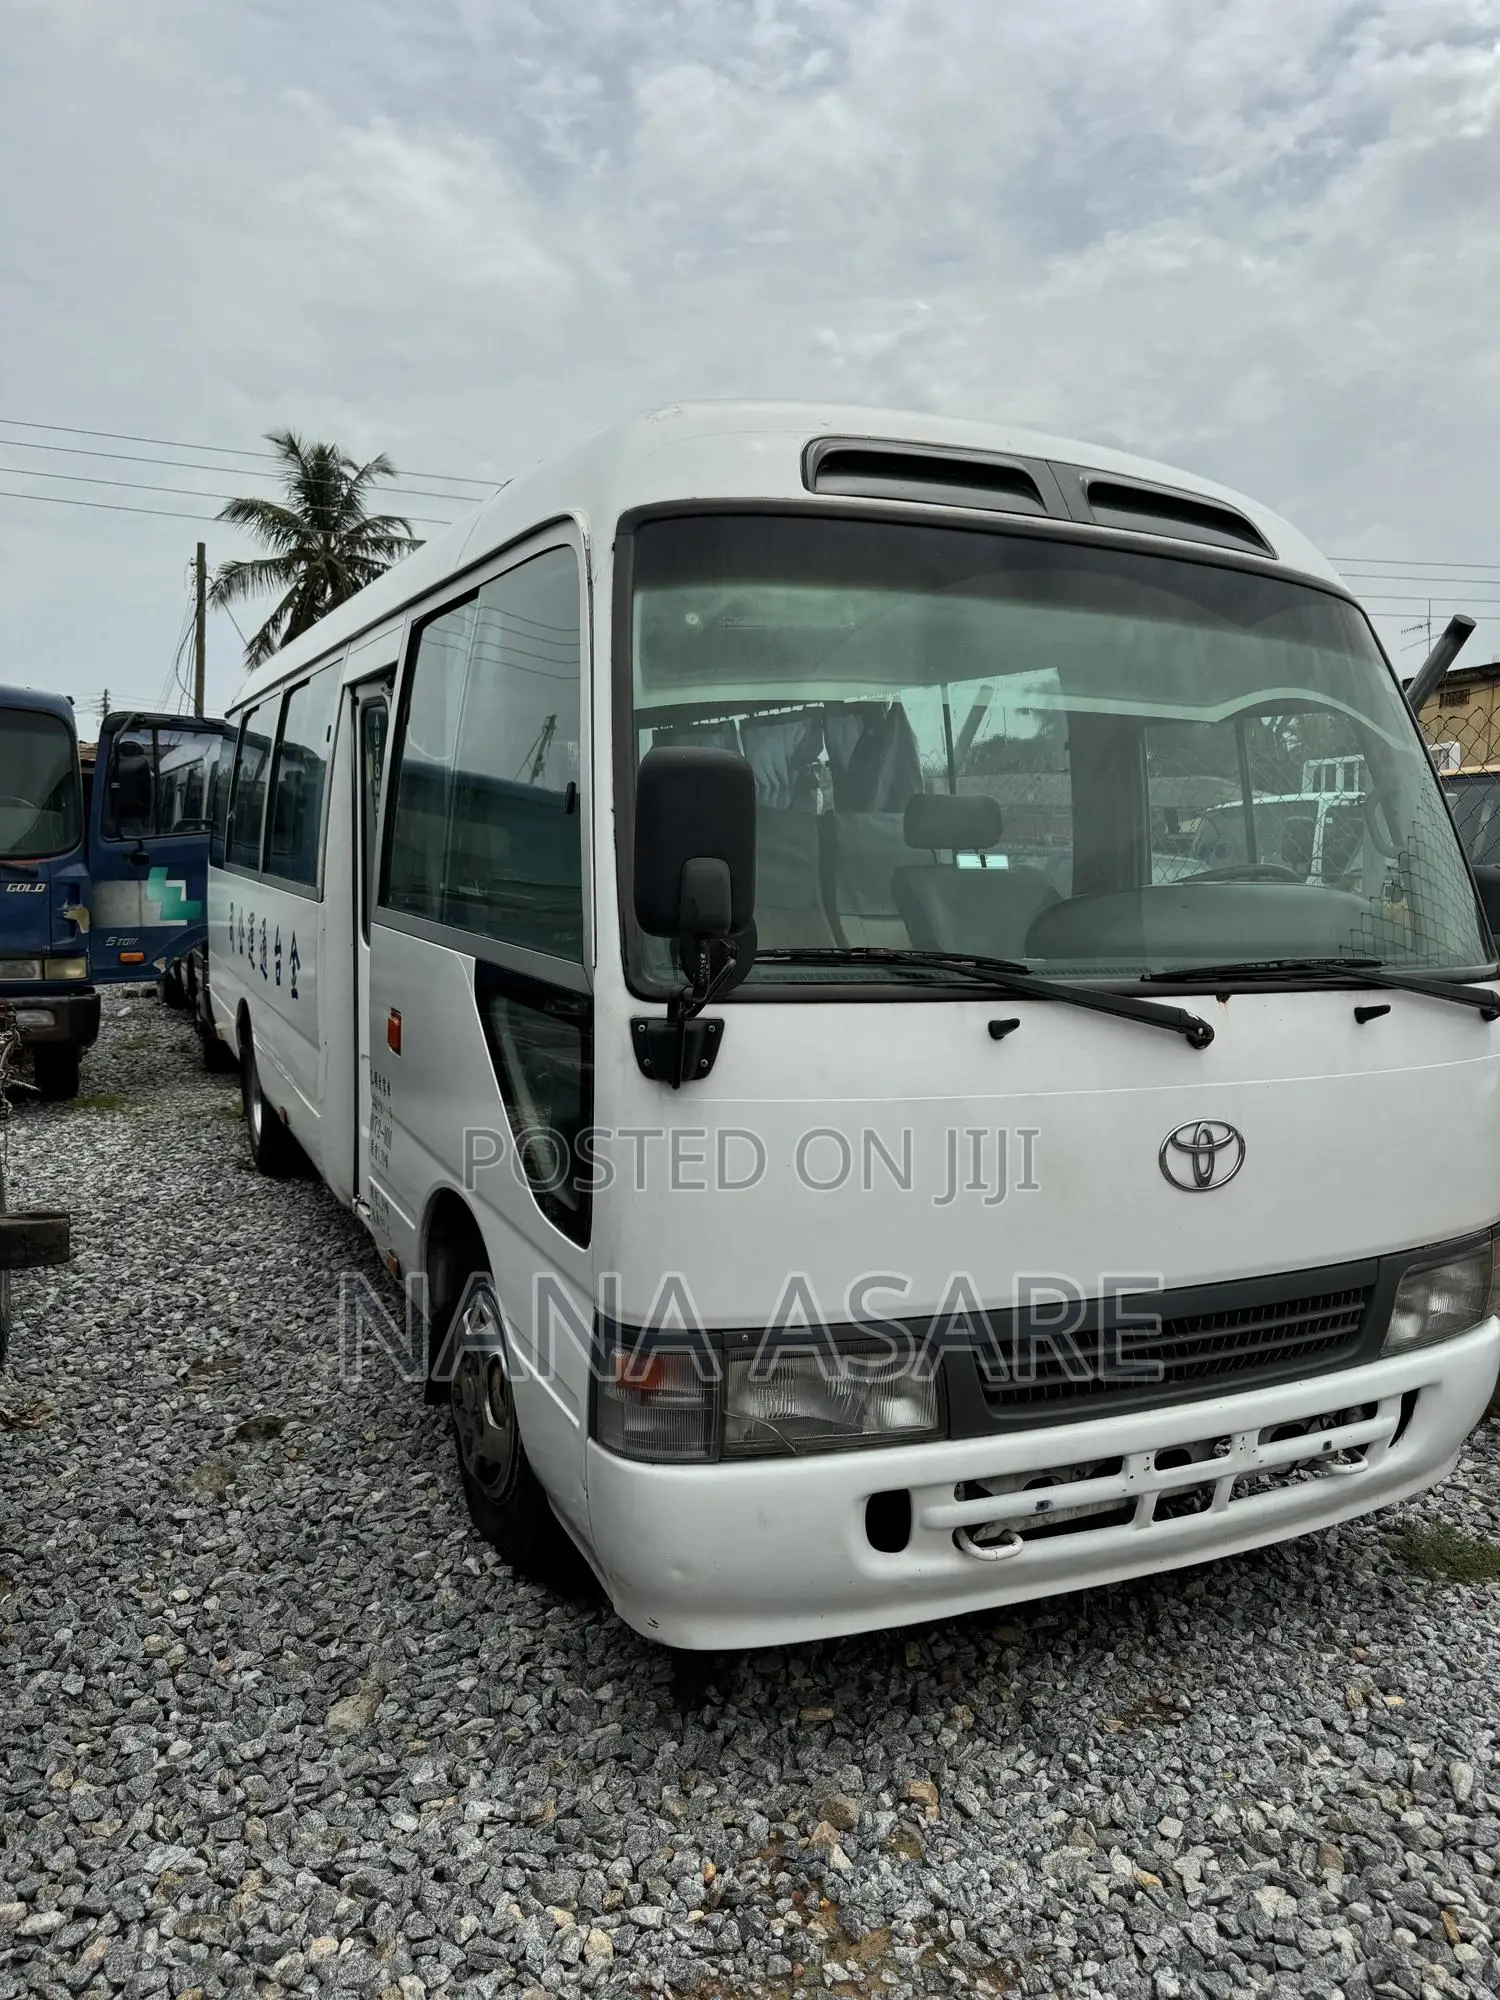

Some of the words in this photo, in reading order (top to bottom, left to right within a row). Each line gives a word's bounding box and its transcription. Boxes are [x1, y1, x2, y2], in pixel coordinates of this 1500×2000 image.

[6, 883, 46, 893] GOLD
[105, 936, 118, 947] 5
[117, 937, 139, 947] TON
